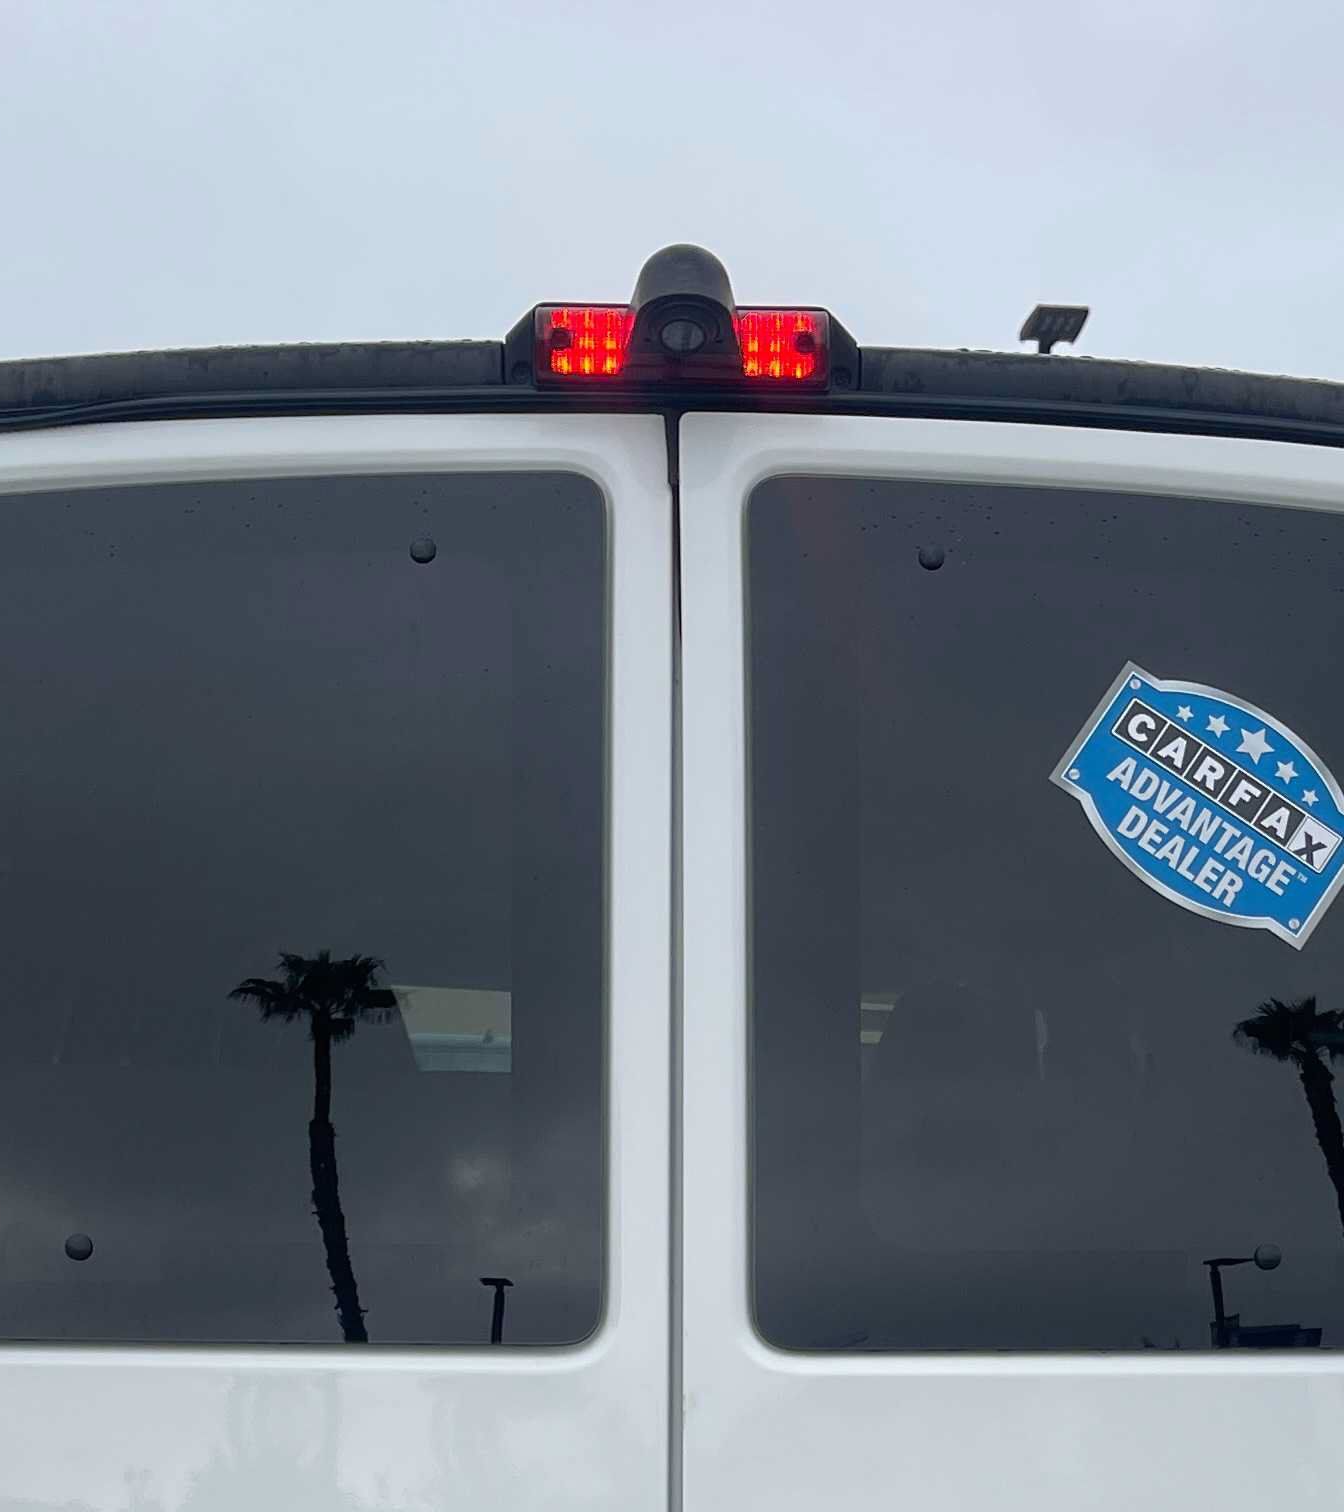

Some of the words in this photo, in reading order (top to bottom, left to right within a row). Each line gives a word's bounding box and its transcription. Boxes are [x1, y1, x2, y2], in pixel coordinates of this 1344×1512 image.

[1106, 756, 1297, 896] ADVANTAGE
[1116, 804, 1244, 908] DEALER
[1124, 710, 1330, 869] CARFAX
